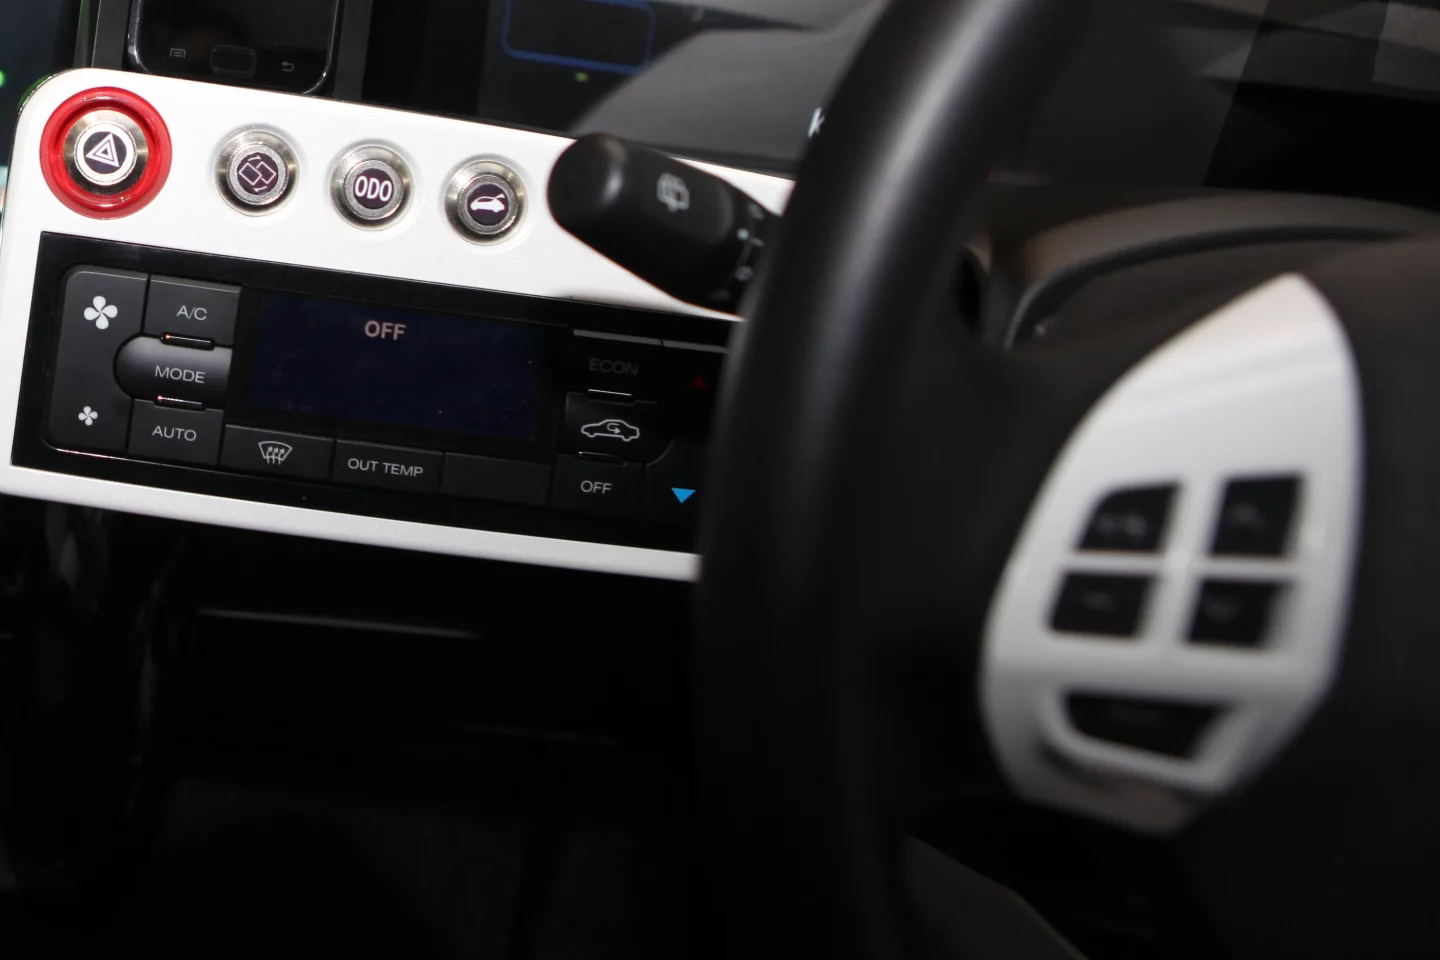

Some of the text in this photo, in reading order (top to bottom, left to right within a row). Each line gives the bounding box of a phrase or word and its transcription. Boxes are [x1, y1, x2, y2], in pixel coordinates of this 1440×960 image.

[354, 175, 393, 202] ODO
[176, 305, 208, 321] A/C
[364, 320, 406, 340] OFF
[154, 365, 206, 384] MODE
[588, 358, 639, 376] ECON
[151, 425, 197, 441] AUTO
[347, 458, 424, 478] OUT TEMP
[580, 480, 613, 494] OFF
